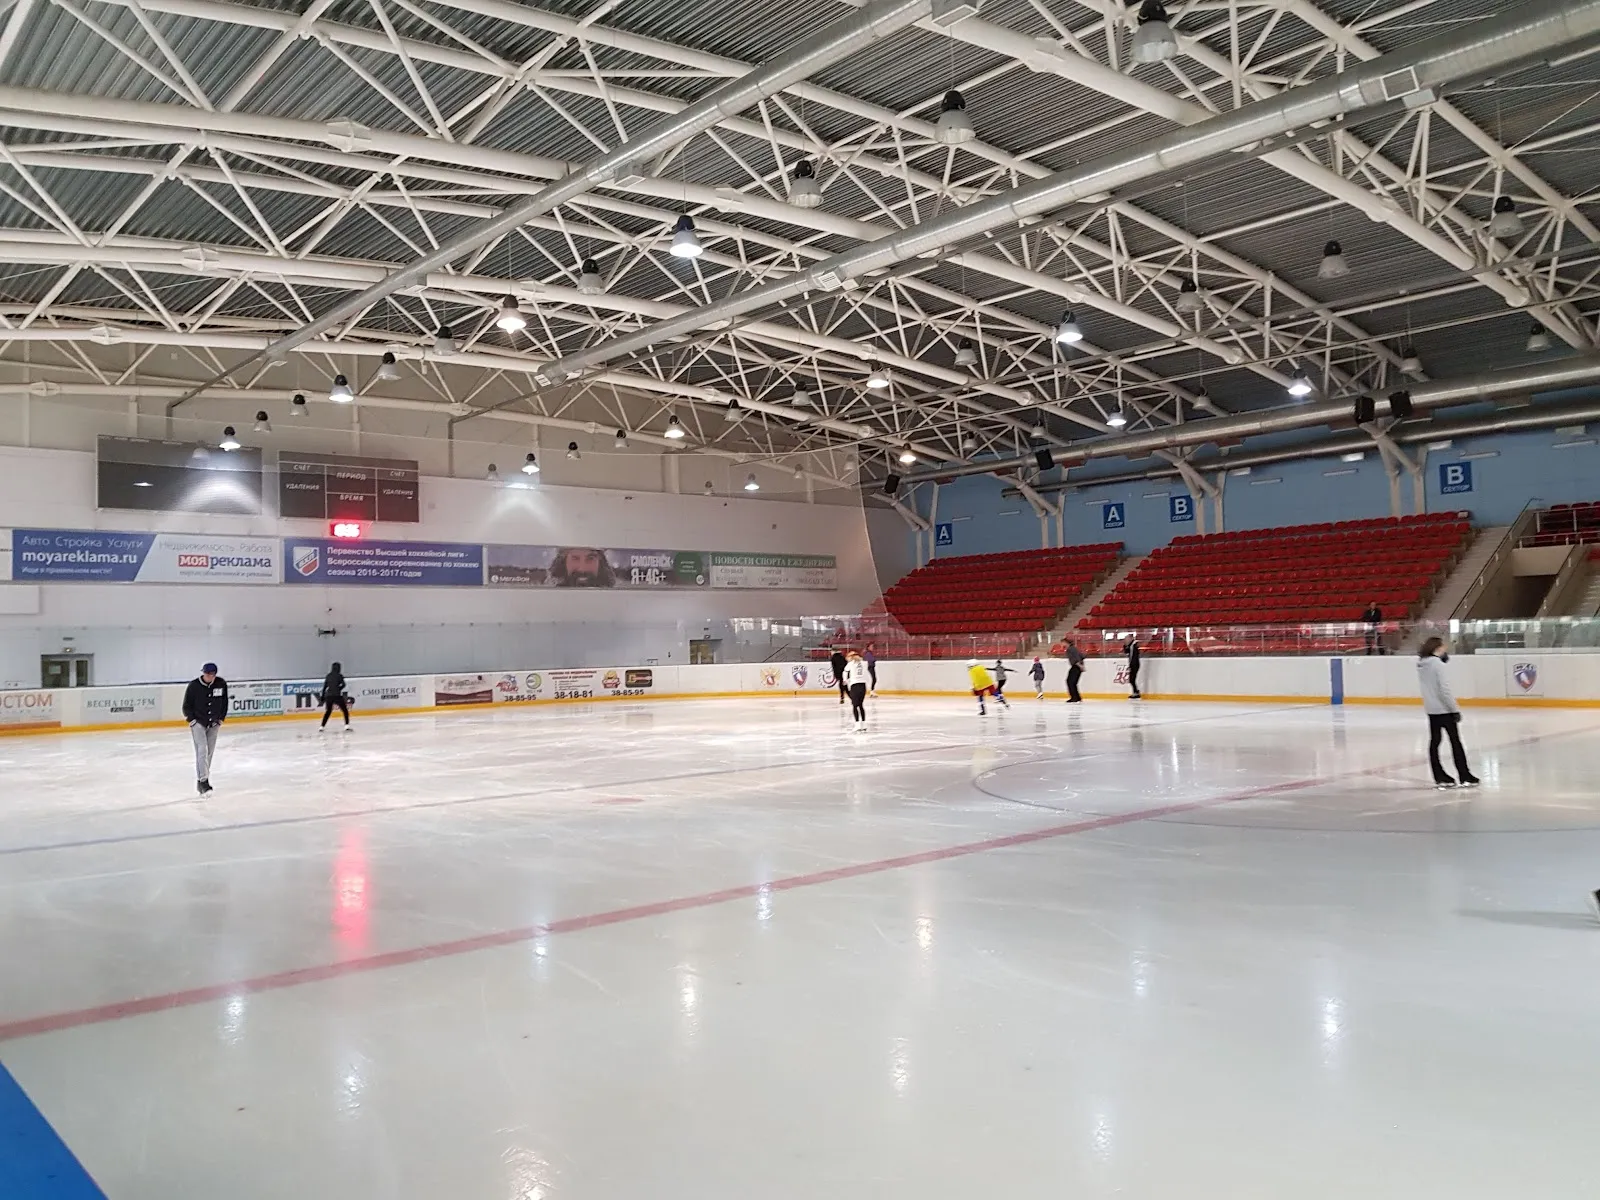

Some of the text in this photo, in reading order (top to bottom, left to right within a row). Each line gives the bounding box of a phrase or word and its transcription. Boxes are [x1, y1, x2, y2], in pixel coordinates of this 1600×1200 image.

[336, 471, 367, 481] ПЕРИОД
[285, 482, 321, 491] УДАЛЕНИЯ
[339, 493, 364, 502] ВРЕМЯ
[21, 535, 143, 551] Авто Стройка Услуги
[160, 541, 273, 553] Недвижимость Работа
[22, 549, 138, 565] moyareklama.ru
[326, 546, 374, 557] Первенство
[375, 548, 407, 557] Высшей
[408, 549, 446, 558] хоккейной
[179, 555, 272, 570] моя реклама
[326, 557, 389, 567] Всероссийское
[714, 556, 755, 566] НОВОСТИ
[756, 557, 786, 567] СПОРТА
[326, 569, 356, 577] сезона
[286, 685, 324, 694] Рабочи
[361, 686, 417, 696] СМОЛЕНСКАЯ
[553, 690, 593, 700] 38-18-81
[0, 693, 53, 709] СТОМ
[86, 699, 118, 709] ВЕСНА
